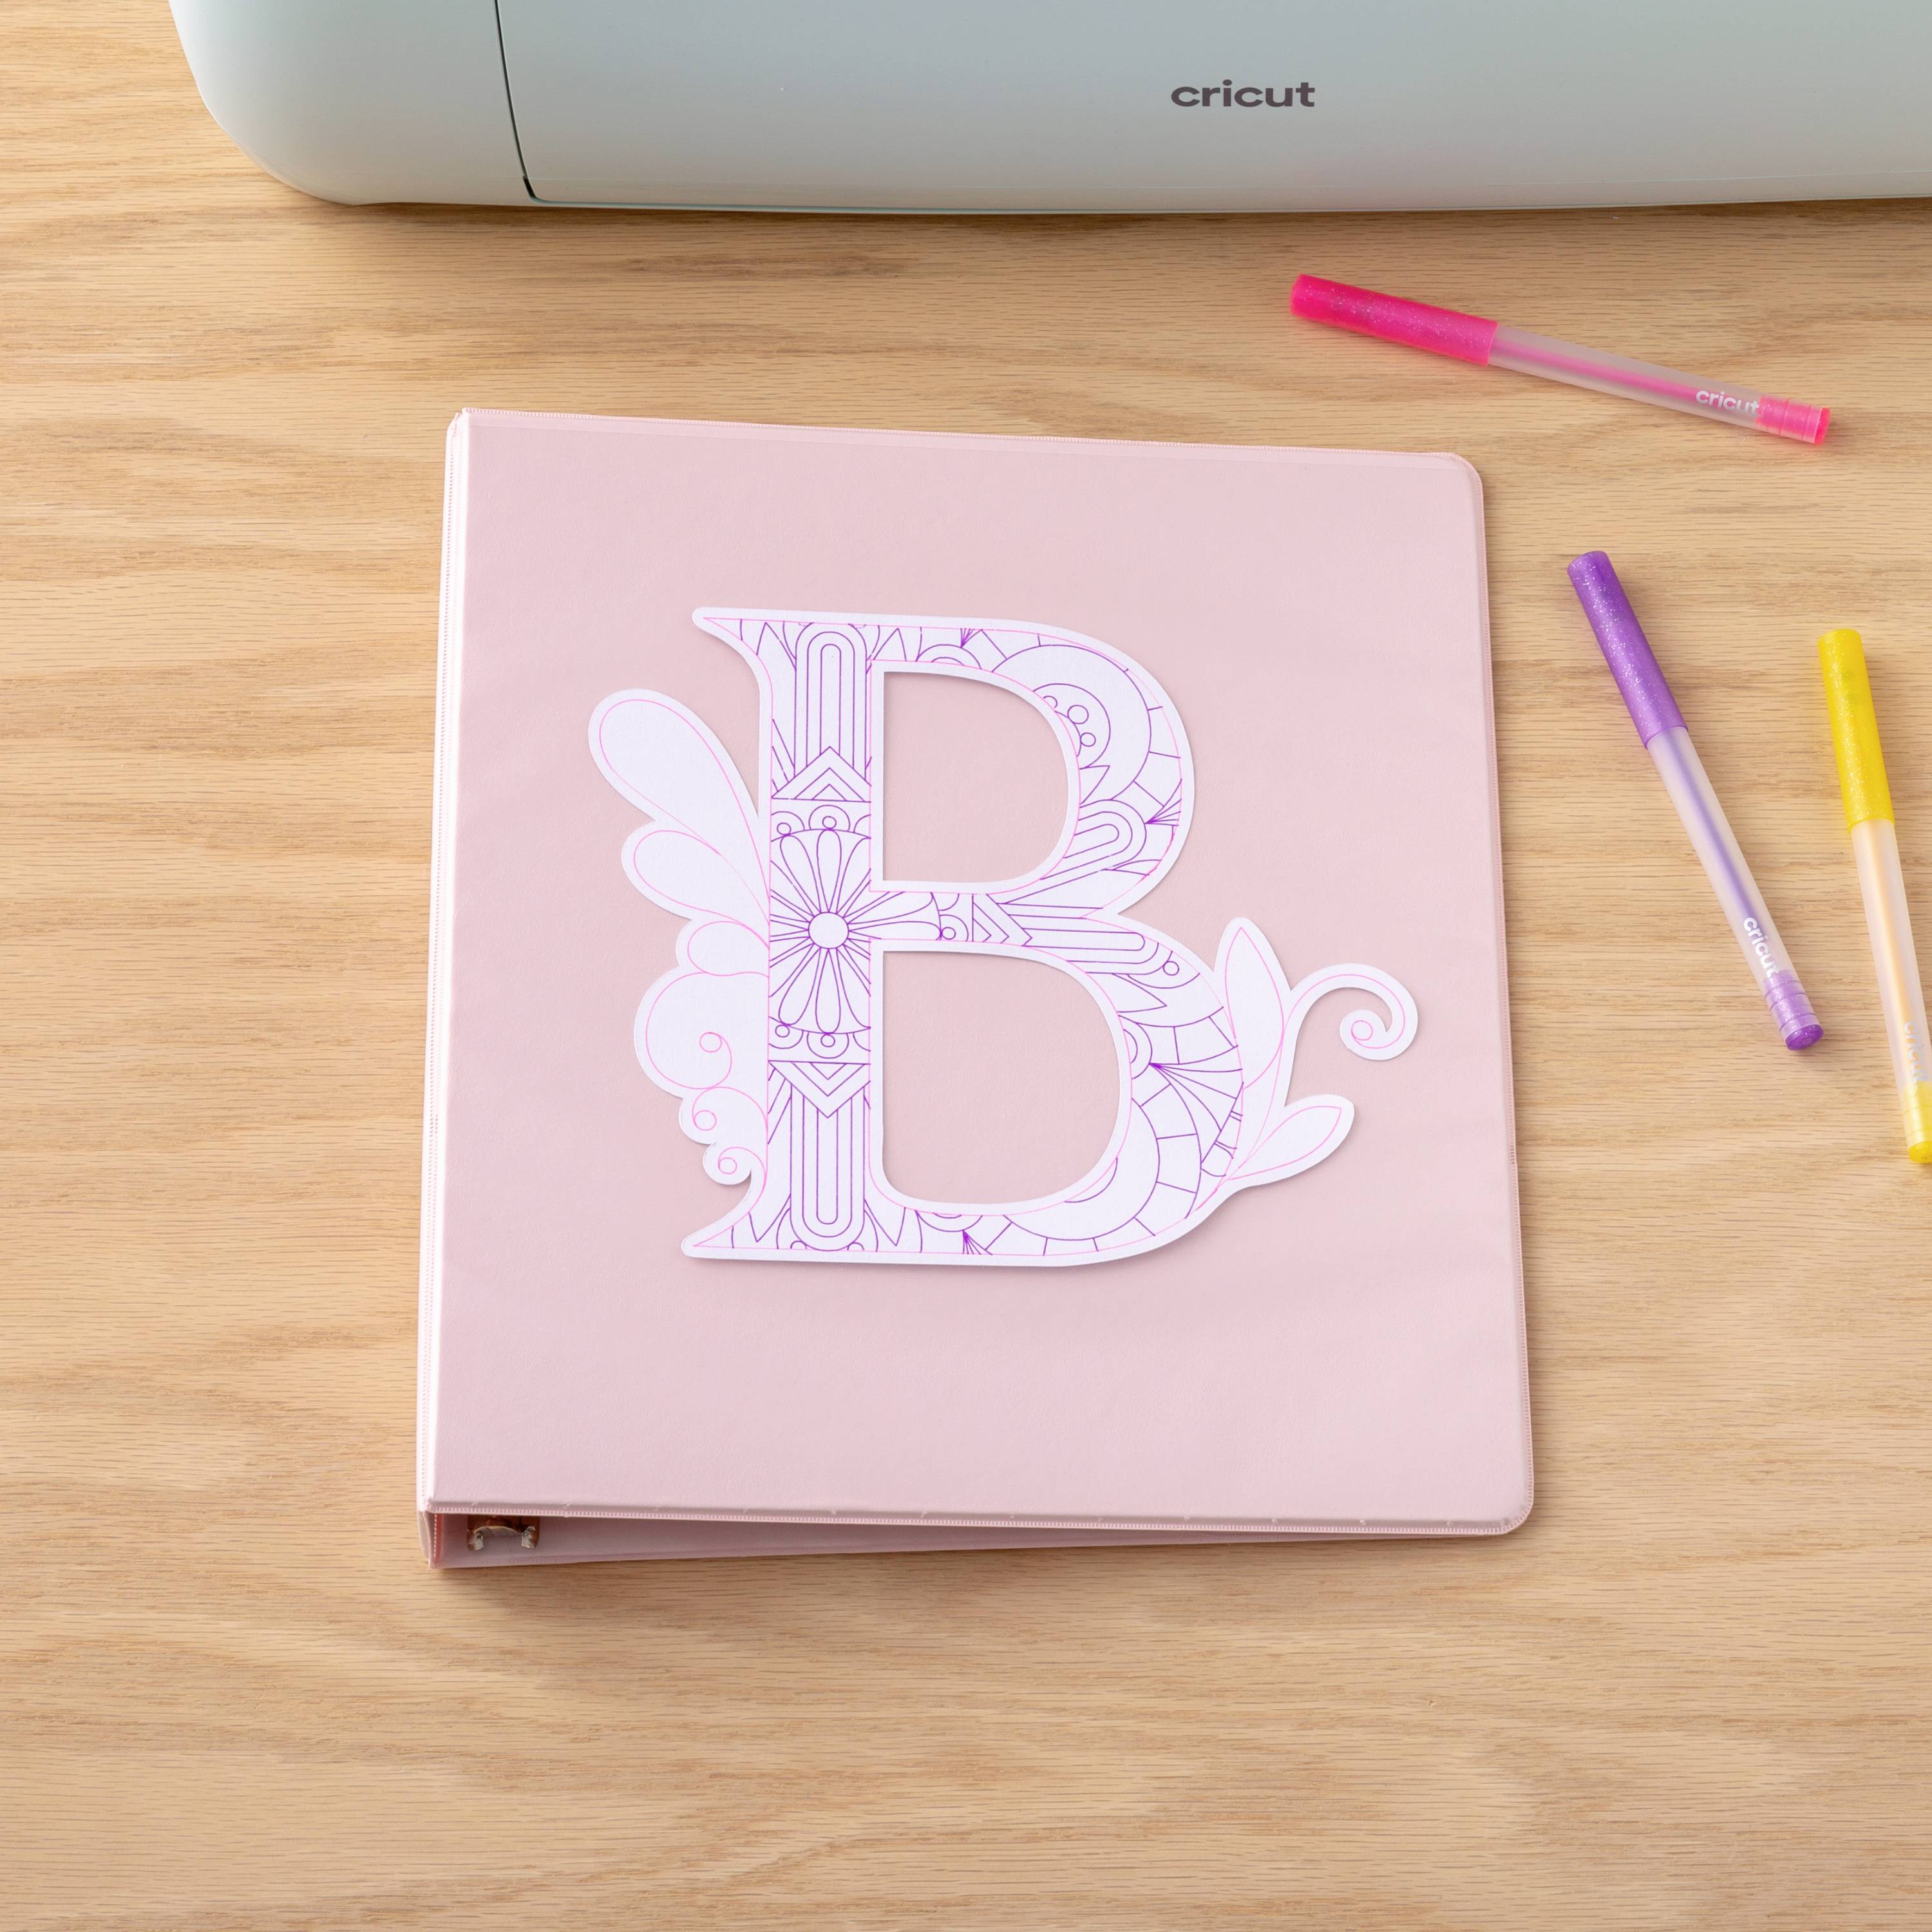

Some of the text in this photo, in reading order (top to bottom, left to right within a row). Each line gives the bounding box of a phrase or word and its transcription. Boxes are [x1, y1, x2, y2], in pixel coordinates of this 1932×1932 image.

[1171, 79, 1315, 107] cricut
[1696, 390, 1759, 415] cricut
[681, 607, 1253, 1267] B
[1743, 917, 1781, 978] cricut
